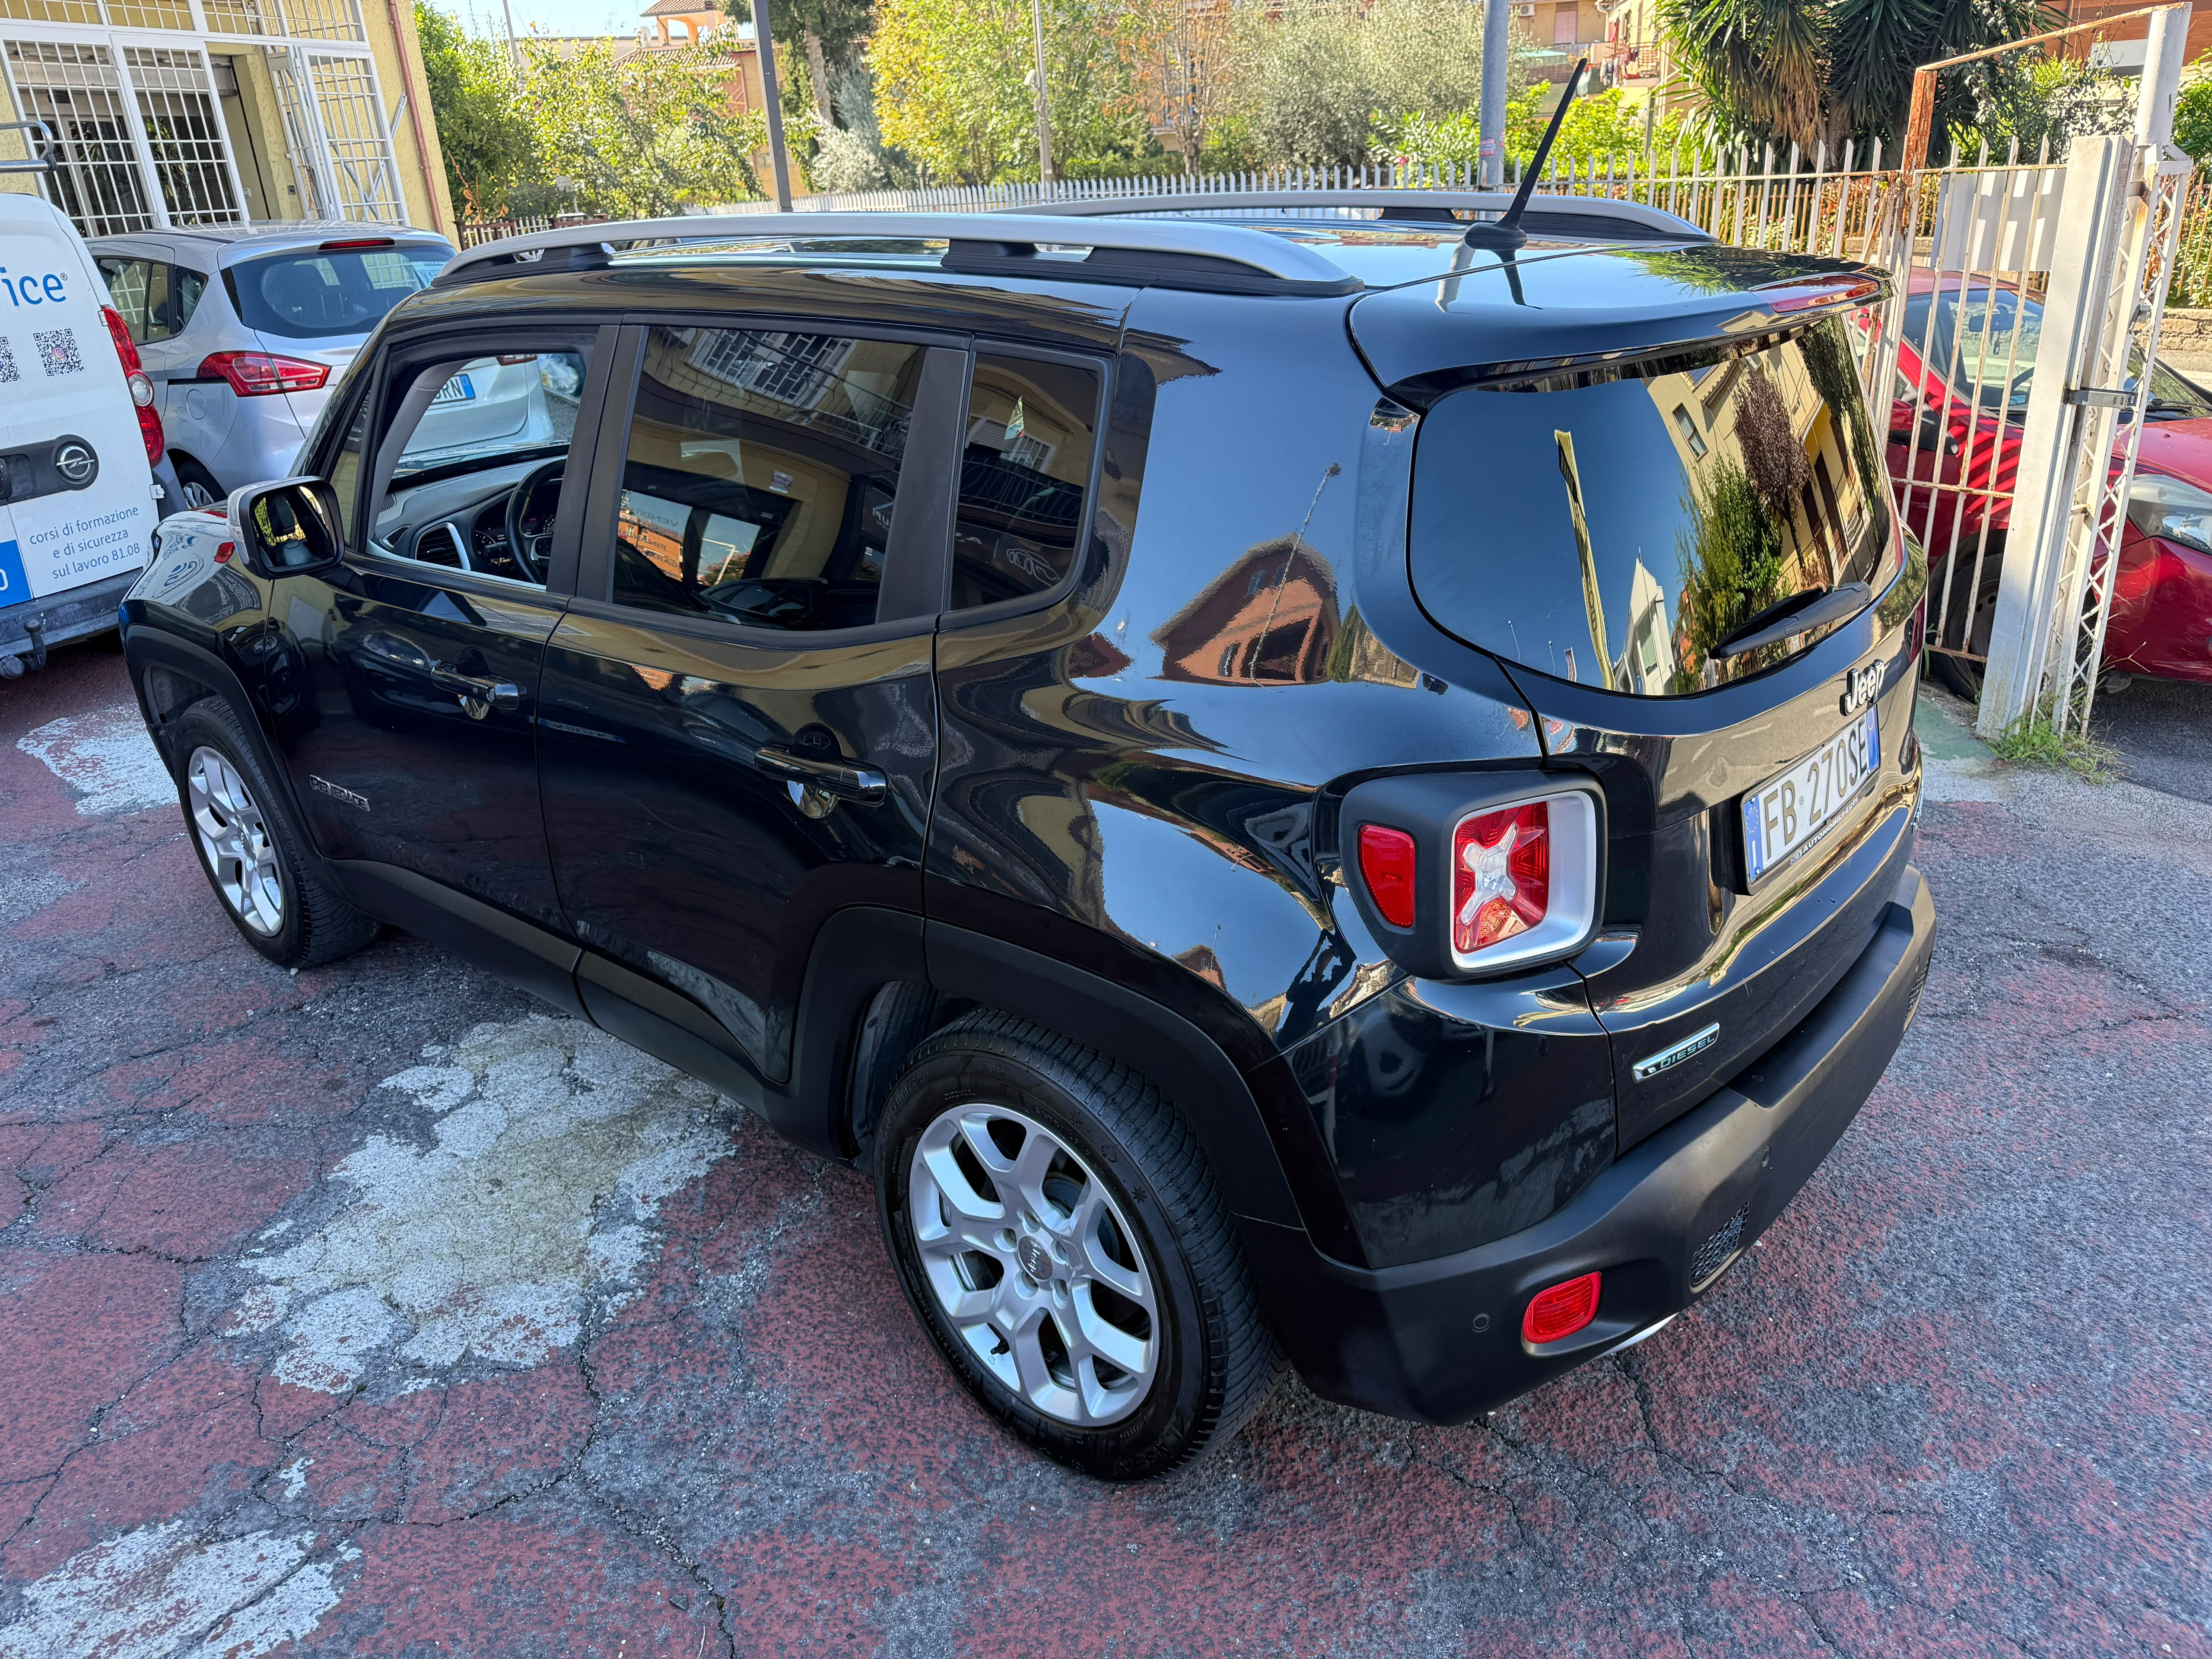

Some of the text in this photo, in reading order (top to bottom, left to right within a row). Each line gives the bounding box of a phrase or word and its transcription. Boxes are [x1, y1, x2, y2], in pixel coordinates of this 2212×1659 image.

[29, 506, 139, 544] corsi di formazione
[53, 530, 129, 558] e di sicurezza
[52, 543, 140, 579] sul lavoro 81.08
[1840, 659, 1885, 716] Jeep
[309, 774, 371, 812] RENEGADE
[1764, 779, 1797, 859] FB
[1807, 716, 1869, 826] 270SE
[1803, 796, 1858, 853] AUTOMOBILI ZUPI
[1660, 1036, 1715, 1069] DIESEL
